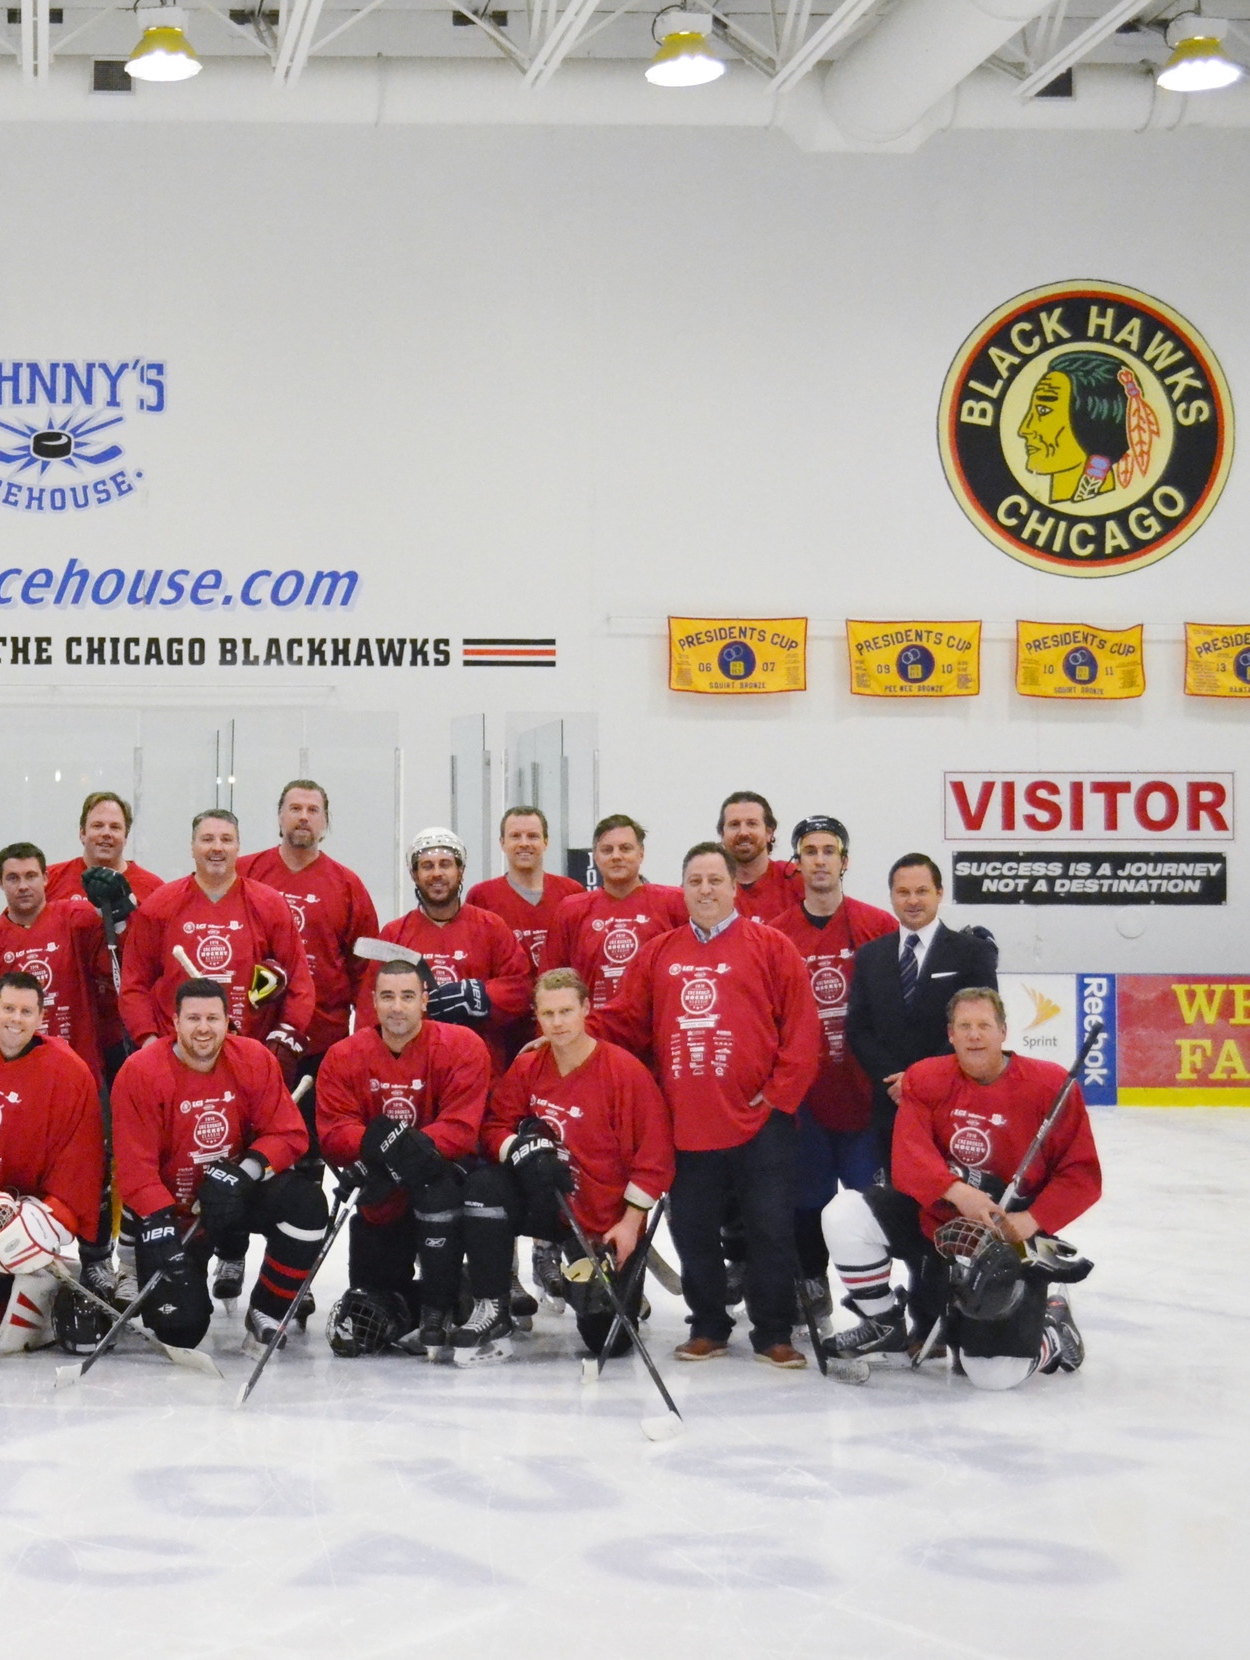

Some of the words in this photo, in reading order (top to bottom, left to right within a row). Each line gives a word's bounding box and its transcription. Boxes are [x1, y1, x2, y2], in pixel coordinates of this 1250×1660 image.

[960, 307, 1072, 427] BLACK
[1087, 305, 1211, 427] HAWKS
[996, 485, 1186, 557] CHICAGO
[678, 626, 767, 651] PRESIDENTS
[771, 633, 799, 652] CUP
[855, 629, 943, 656] PRESIDENTS
[946, 635, 972, 653] CUP
[1025, 631, 1107, 655] PRESIDENTS
[1109, 643, 1136, 657] CUP
[66, 636, 206, 667] CHICAGO
[218, 636, 451, 668] BLACKHAWKS
[698, 662, 712, 672] 06
[762, 662, 776, 672] 07
[877, 664, 891, 674] 09
[941, 664, 953, 673] 10
[949, 780, 1230, 832] VISITOR
[955, 862, 1063, 877] SUCCESS
[1068, 862, 1092, 877] IS
[1096, 862, 1112, 876] A
[1116, 862, 1223, 877] JOURNEY
[981, 879, 1029, 893] NOT
[1032, 879, 1048, 892] A
[1054, 879, 1202, 893] DESTINATION
[1023, 1036, 1058, 1049] Sprint
